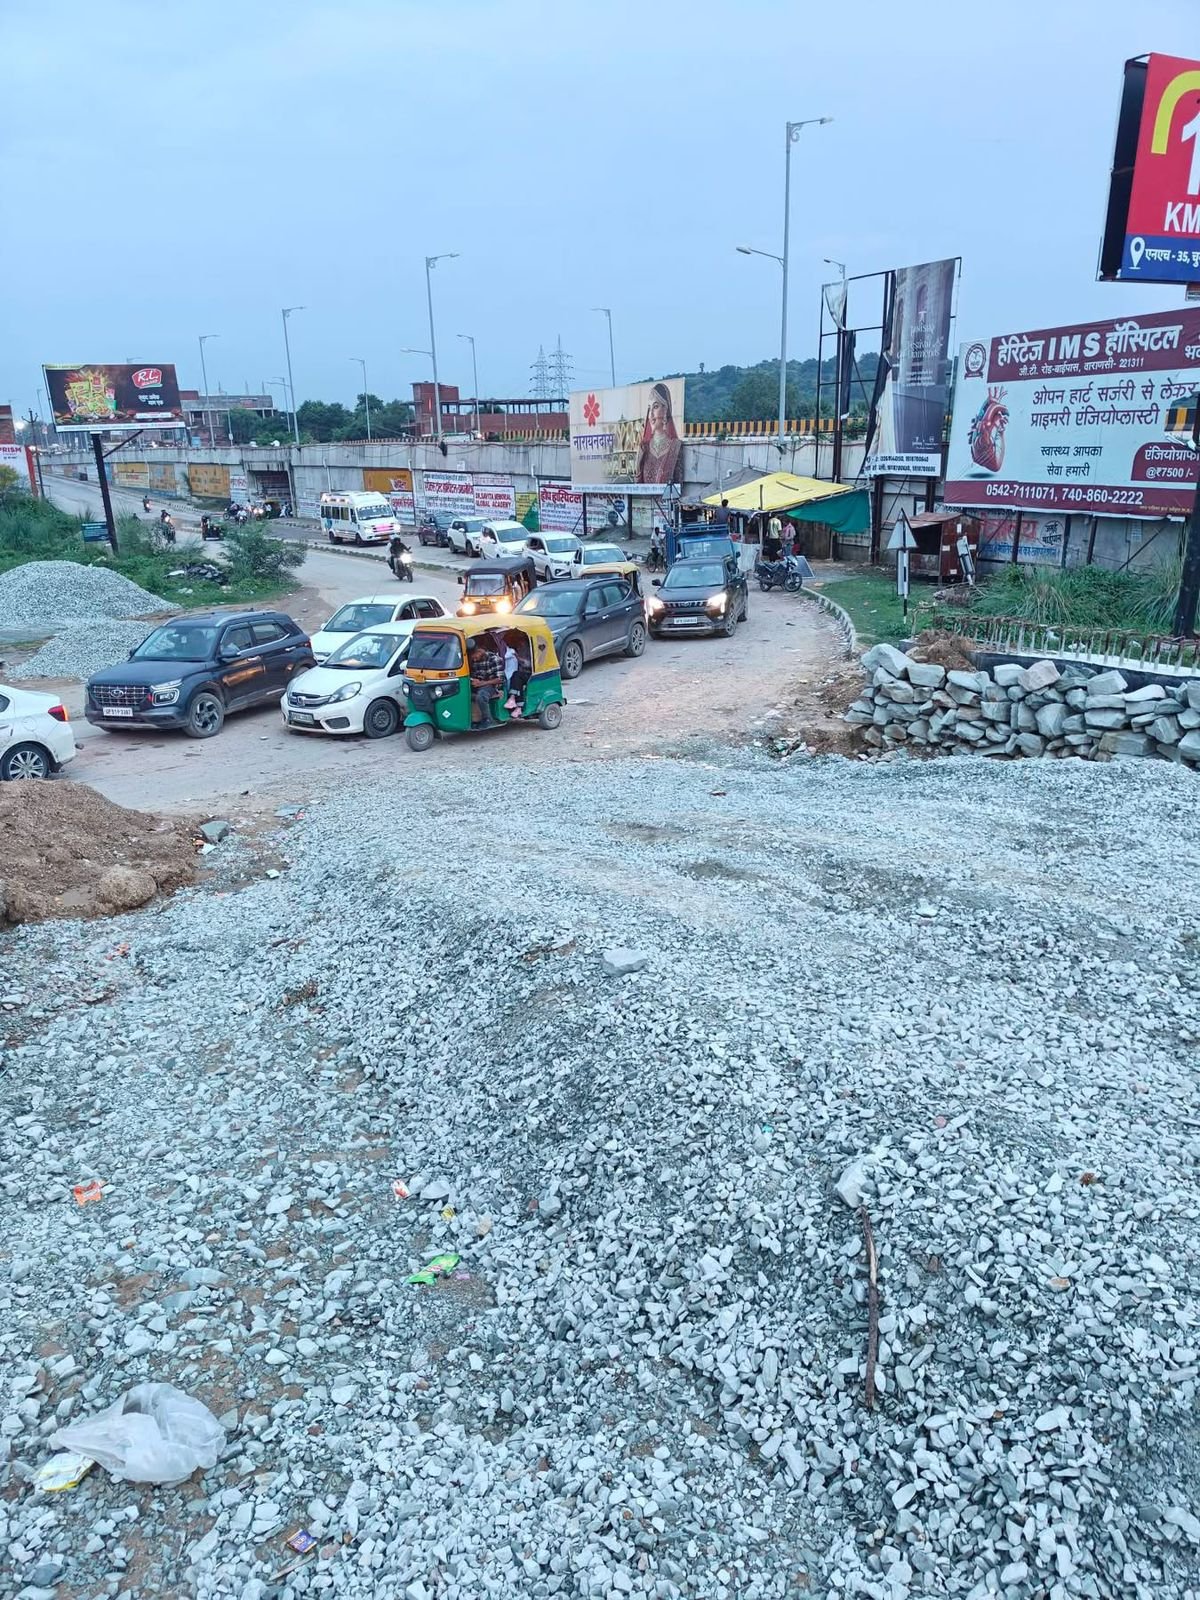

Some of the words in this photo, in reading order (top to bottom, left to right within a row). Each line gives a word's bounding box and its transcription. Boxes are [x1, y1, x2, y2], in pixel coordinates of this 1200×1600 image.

[1145, 249, 1171, 261] एनएच
[1177, 250, 1190, 264] 35,
[997, 334, 1045, 366] हेरिटेज
[1047, 331, 1100, 361] IMS
[1104, 320, 1183, 355] हॉस्पिटल
[1032, 384, 1065, 405] ओपन
[1070, 381, 1094, 405] हार्ट
[1098, 379, 1136, 402] सर्जरी
[1141, 378, 1156, 400] से
[1030, 405, 1071, 430] प्राइमरी
[1075, 402, 1160, 426] एंजियोप्लास्टी
[1040, 446, 1071, 457] स्वास्थ्य
[1073, 445, 1103, 457] आपका
[1047, 464, 1063, 477] सेवा
[1065, 462, 1090, 477] हमारी
[986, 483, 1058, 502] 0542-7111071,
[1062, 488, 1144, 505] 740-860-2222
